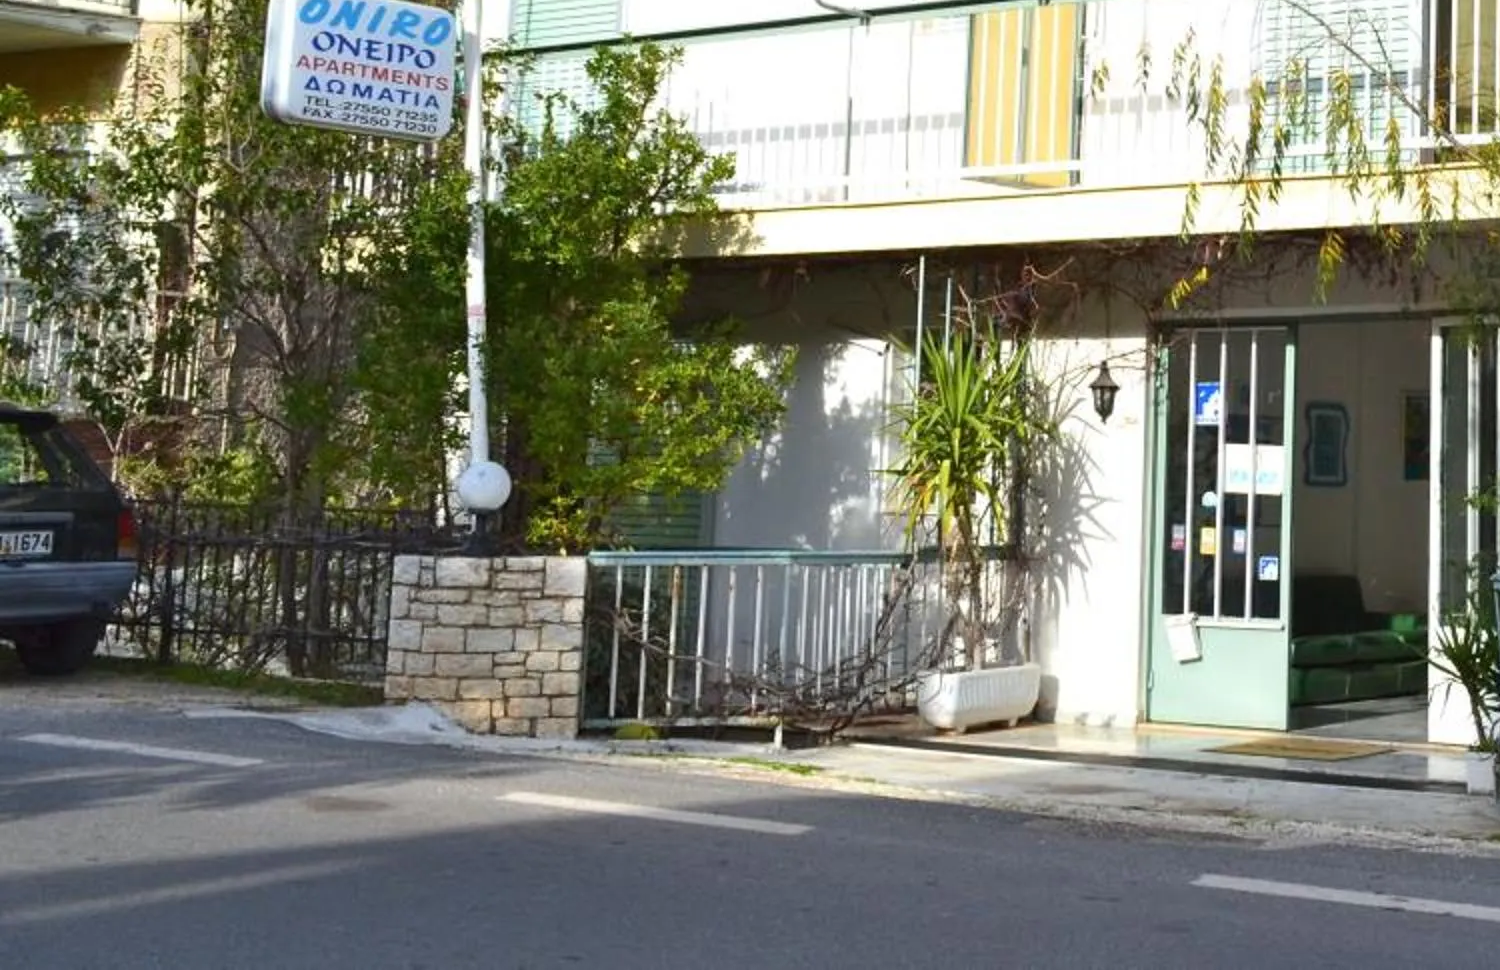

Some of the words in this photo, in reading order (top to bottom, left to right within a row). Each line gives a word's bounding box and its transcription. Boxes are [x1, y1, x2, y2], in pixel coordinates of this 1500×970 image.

[312, 31, 436, 69] ΟΝΕΙΡΟ
[297, 54, 449, 91] APARTMENTS
[304, 76, 439, 109] ΔΩΜΑΤΙΑ
